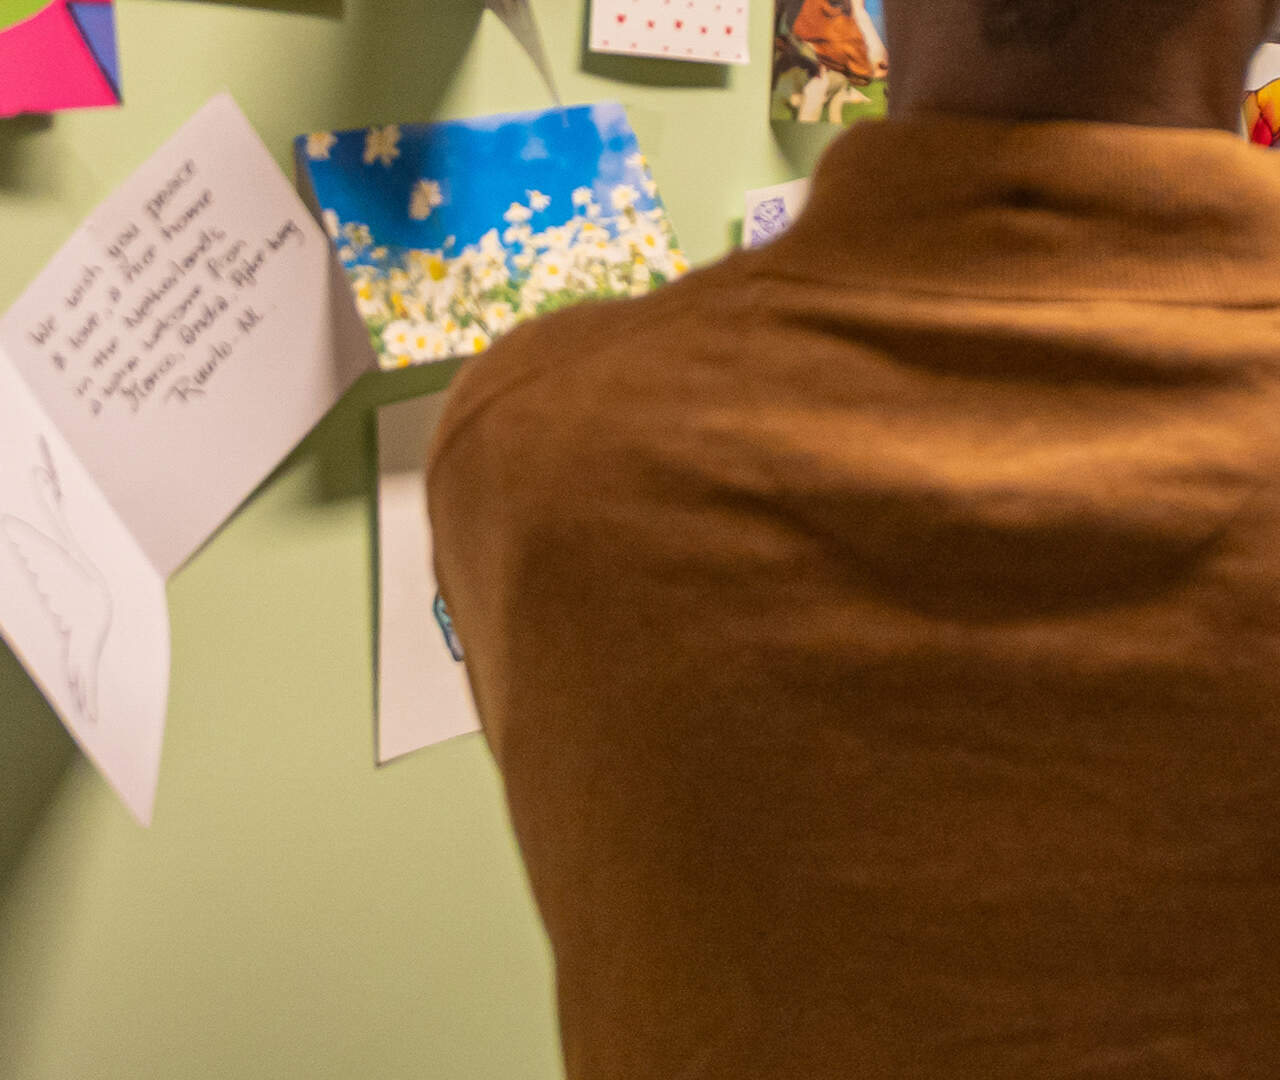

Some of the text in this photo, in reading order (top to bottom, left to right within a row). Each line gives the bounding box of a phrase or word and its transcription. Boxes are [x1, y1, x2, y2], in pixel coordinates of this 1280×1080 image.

[66, 265, 103, 308] wish
[106, 222, 142, 262] you
[145, 159, 196, 220] peace
[94, 336, 120, 368] the
[123, 229, 227, 328] Netherlands
